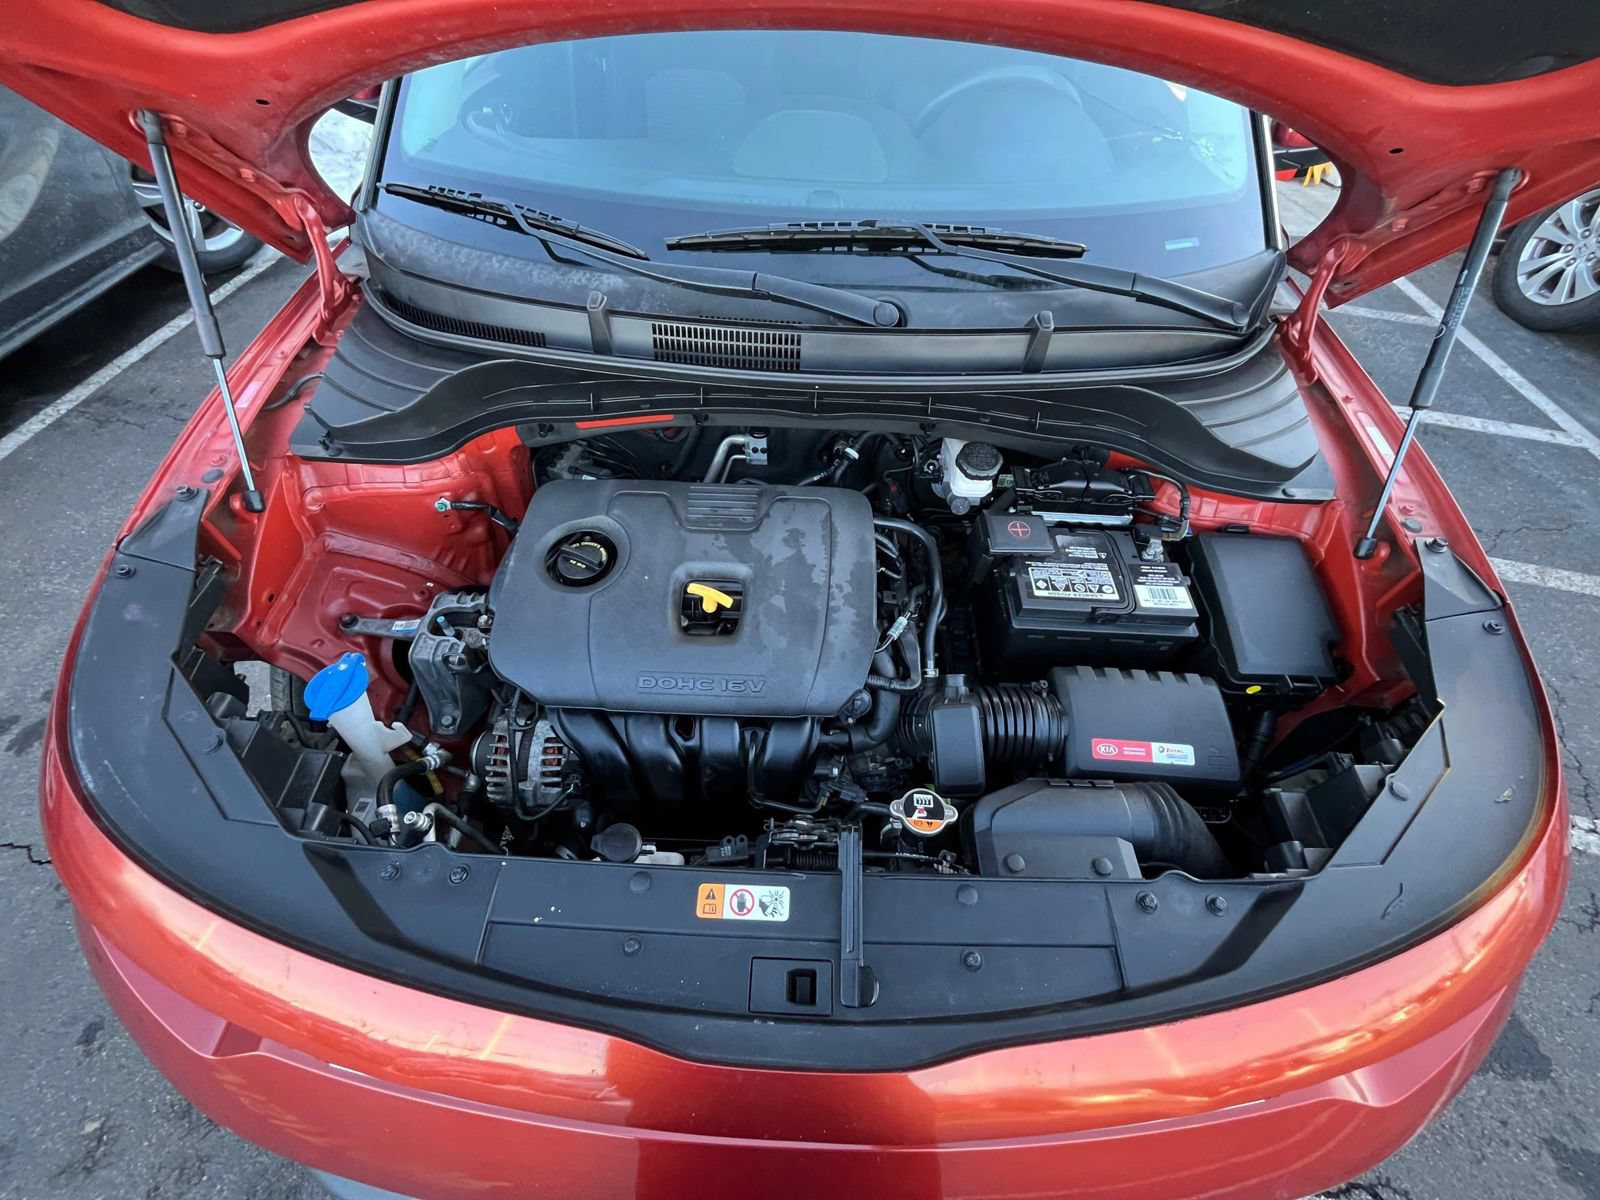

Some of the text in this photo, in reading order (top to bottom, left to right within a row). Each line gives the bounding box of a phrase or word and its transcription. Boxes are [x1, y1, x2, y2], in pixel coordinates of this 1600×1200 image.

[640, 676, 766, 693] DOHC 16V
[1099, 745, 1116, 754] KIA
